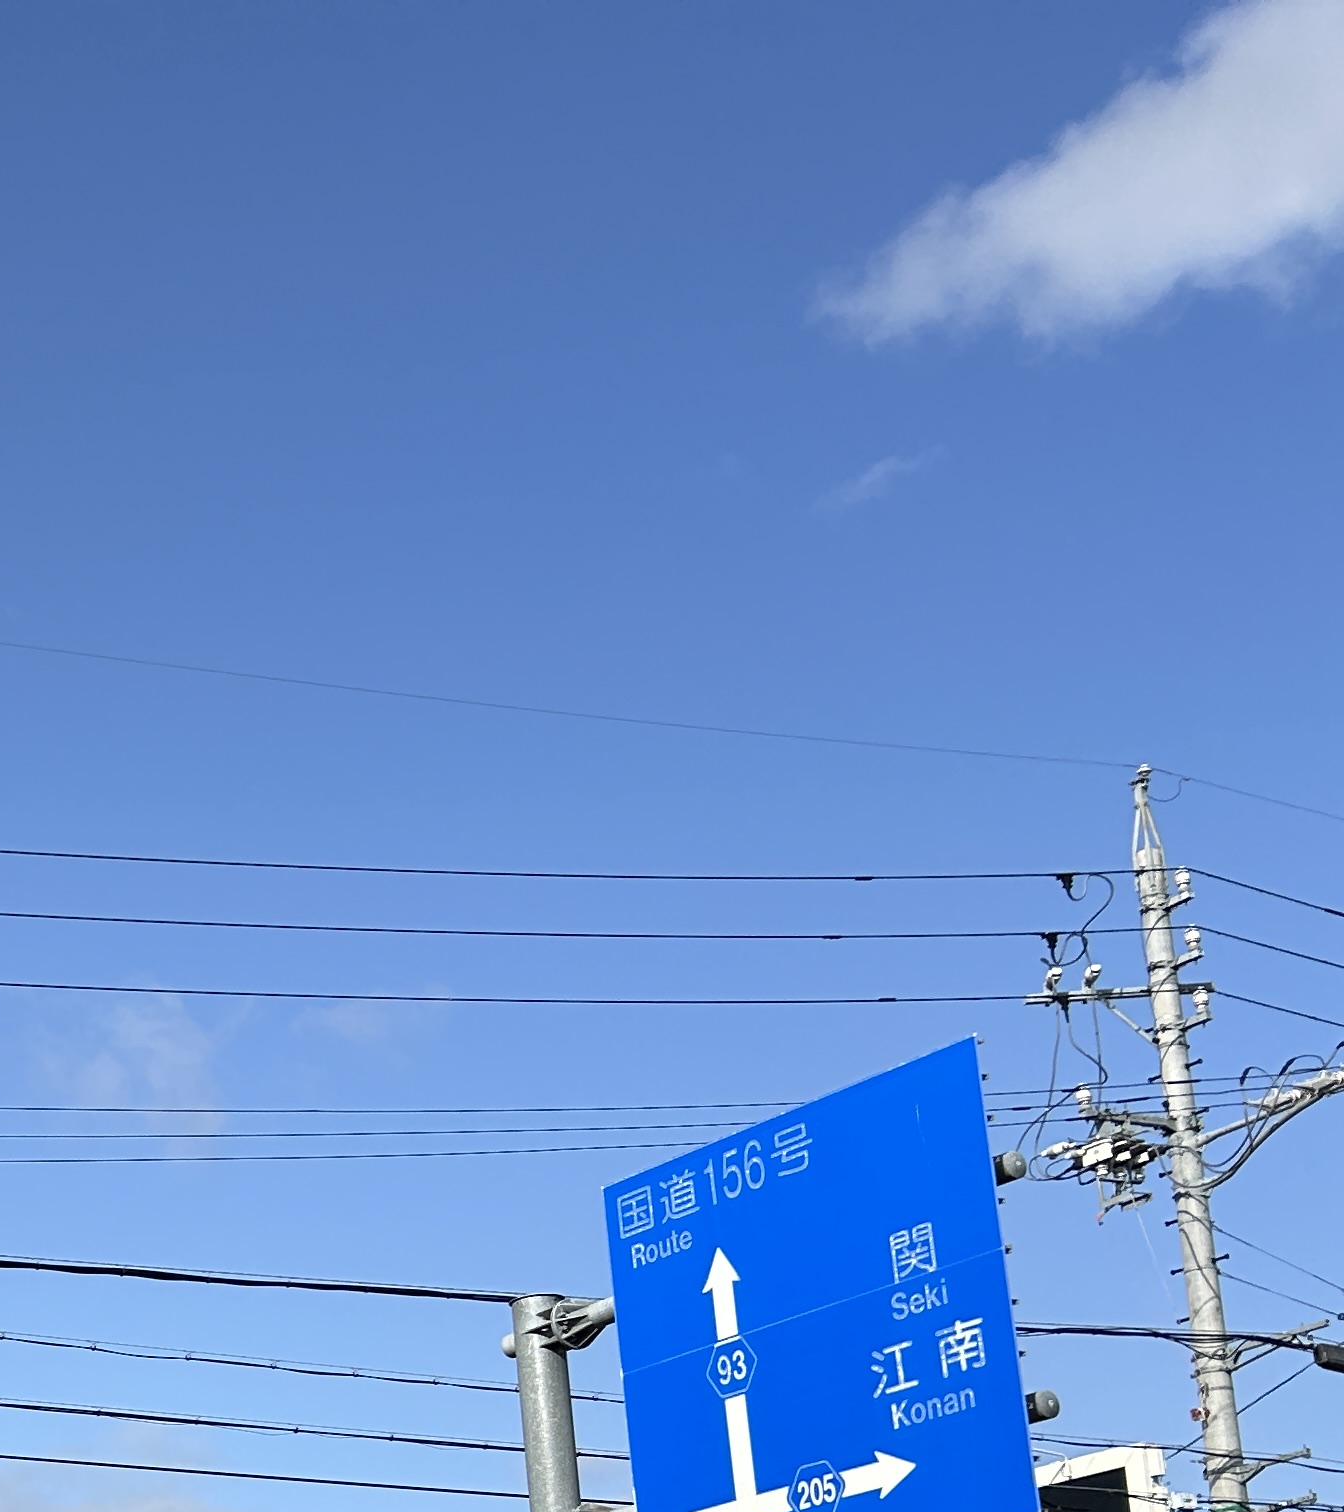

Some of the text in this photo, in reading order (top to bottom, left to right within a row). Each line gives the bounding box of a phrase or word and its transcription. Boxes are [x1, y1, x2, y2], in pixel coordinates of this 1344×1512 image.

[616, 1122, 813, 1239] 国道156号
[631, 1229, 693, 1269] Route
[889, 1221, 938, 1284] 関
[890, 1278, 950, 1321] Seki
[717, 1351, 748, 1386] 93
[871, 1315, 987, 1399] 江南
[891, 1384, 977, 1430] Konan
[796, 1474, 837, 1509] 205
